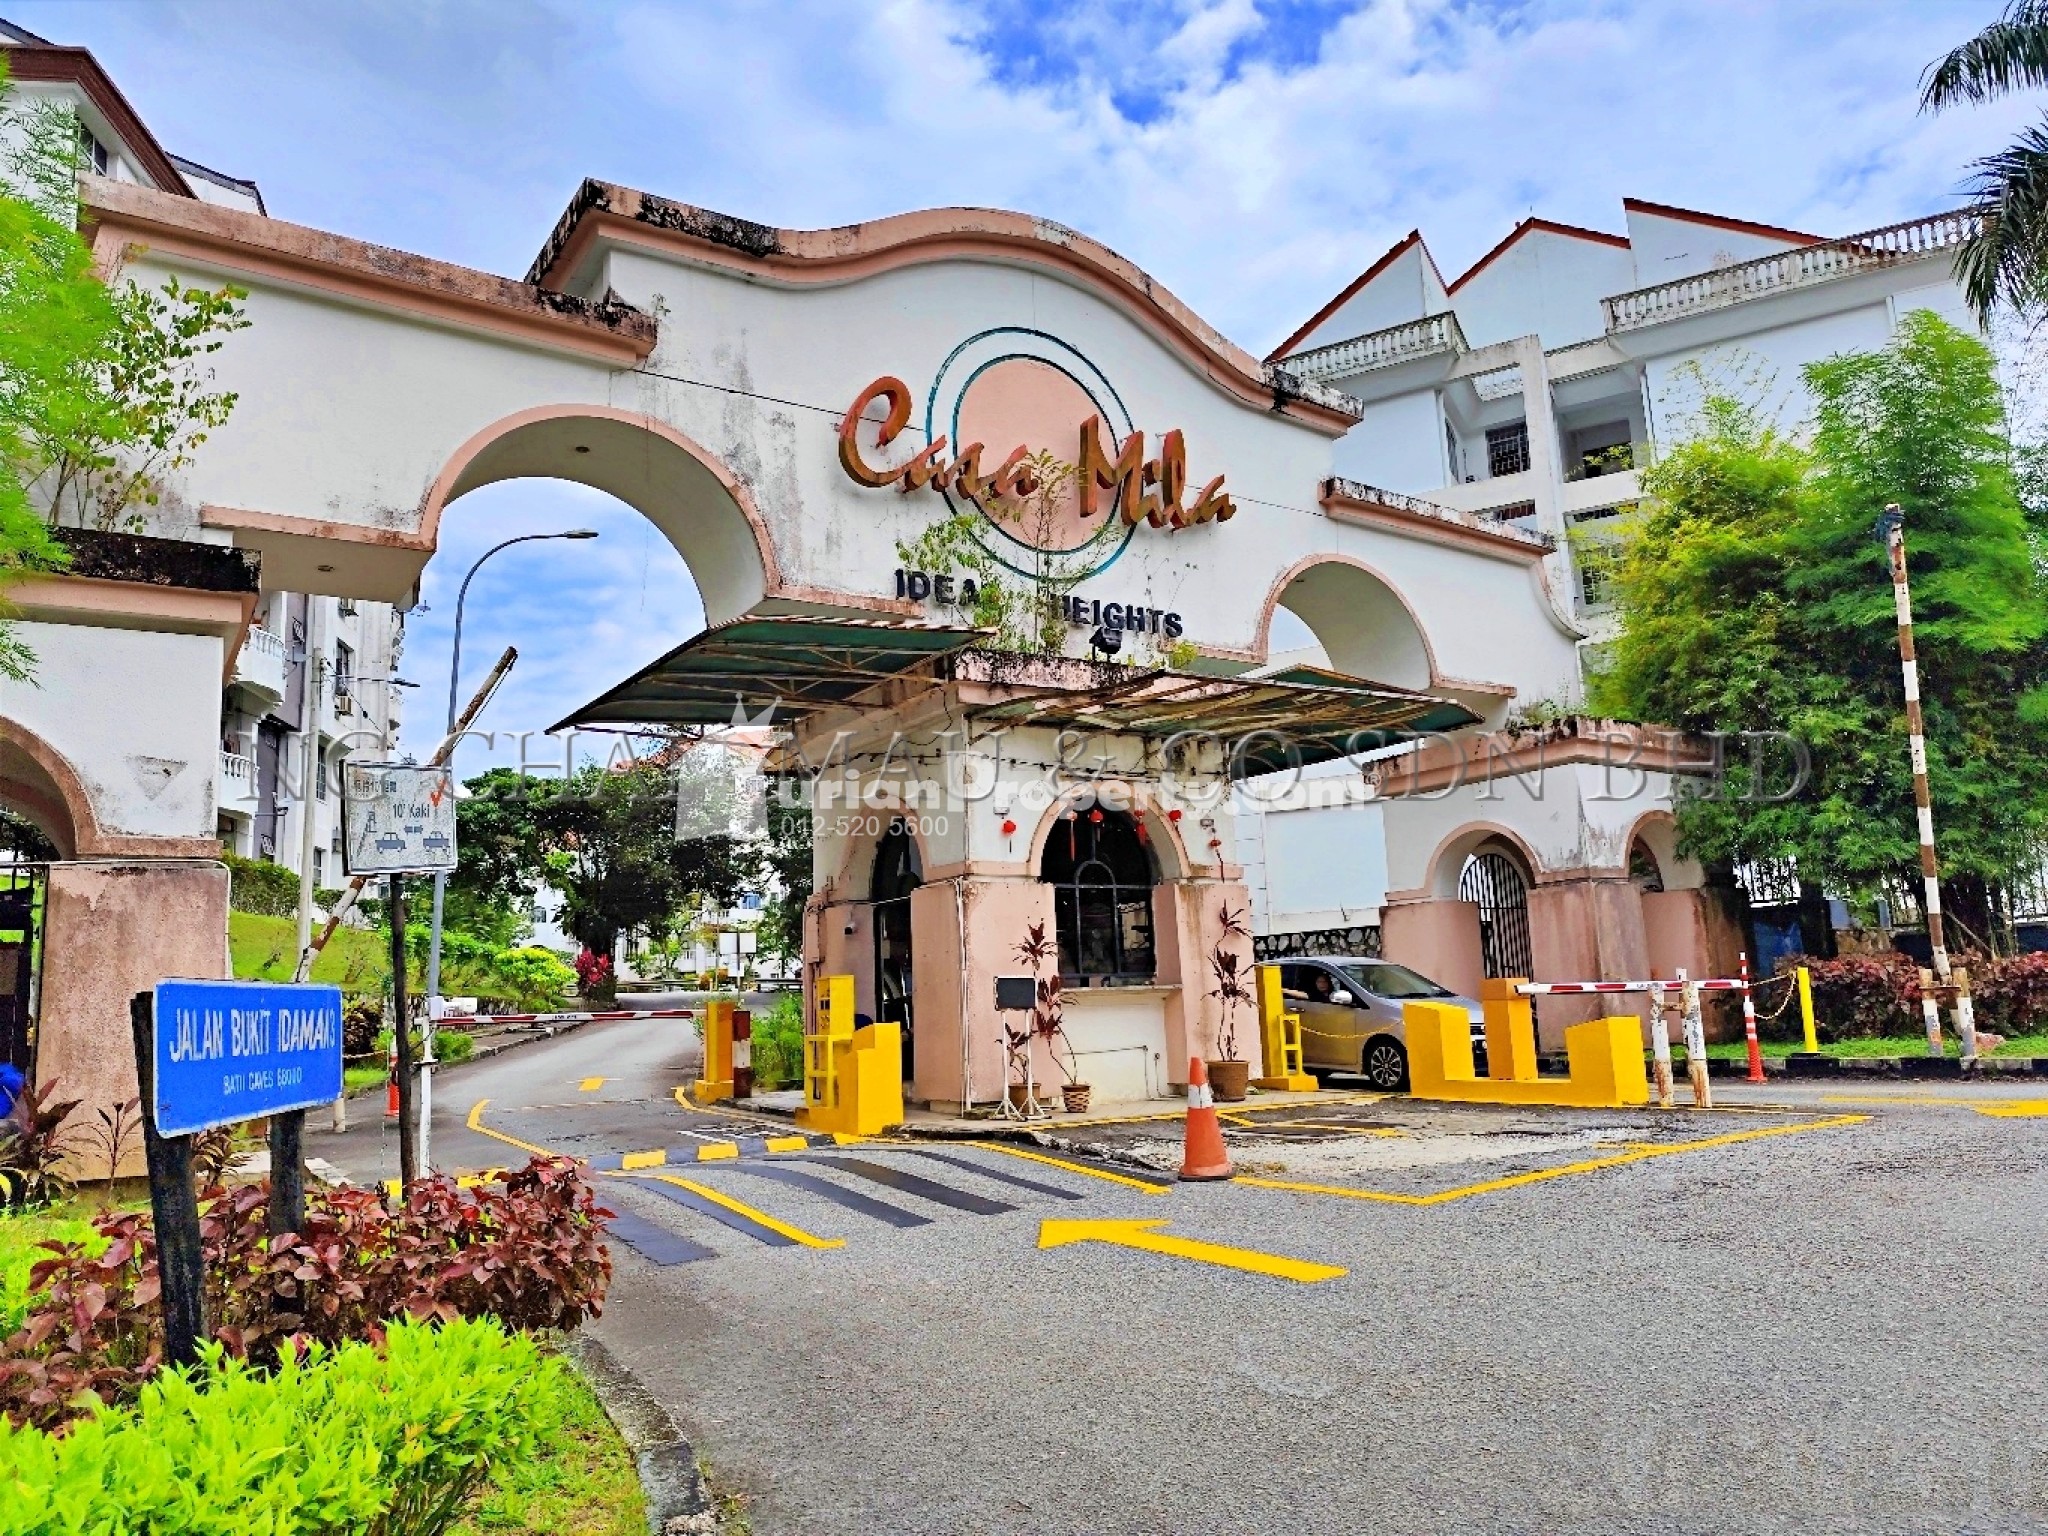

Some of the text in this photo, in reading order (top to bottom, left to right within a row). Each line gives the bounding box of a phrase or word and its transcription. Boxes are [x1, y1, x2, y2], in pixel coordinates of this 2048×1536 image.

[838, 376, 1237, 532] Casa Mila
[168, 1007, 224, 1063] JALAN
[230, 1008, 271, 1057] BUKIT
[278, 1007, 329, 1053] IDAMAN
[248, 1070, 274, 1091] CAVES
